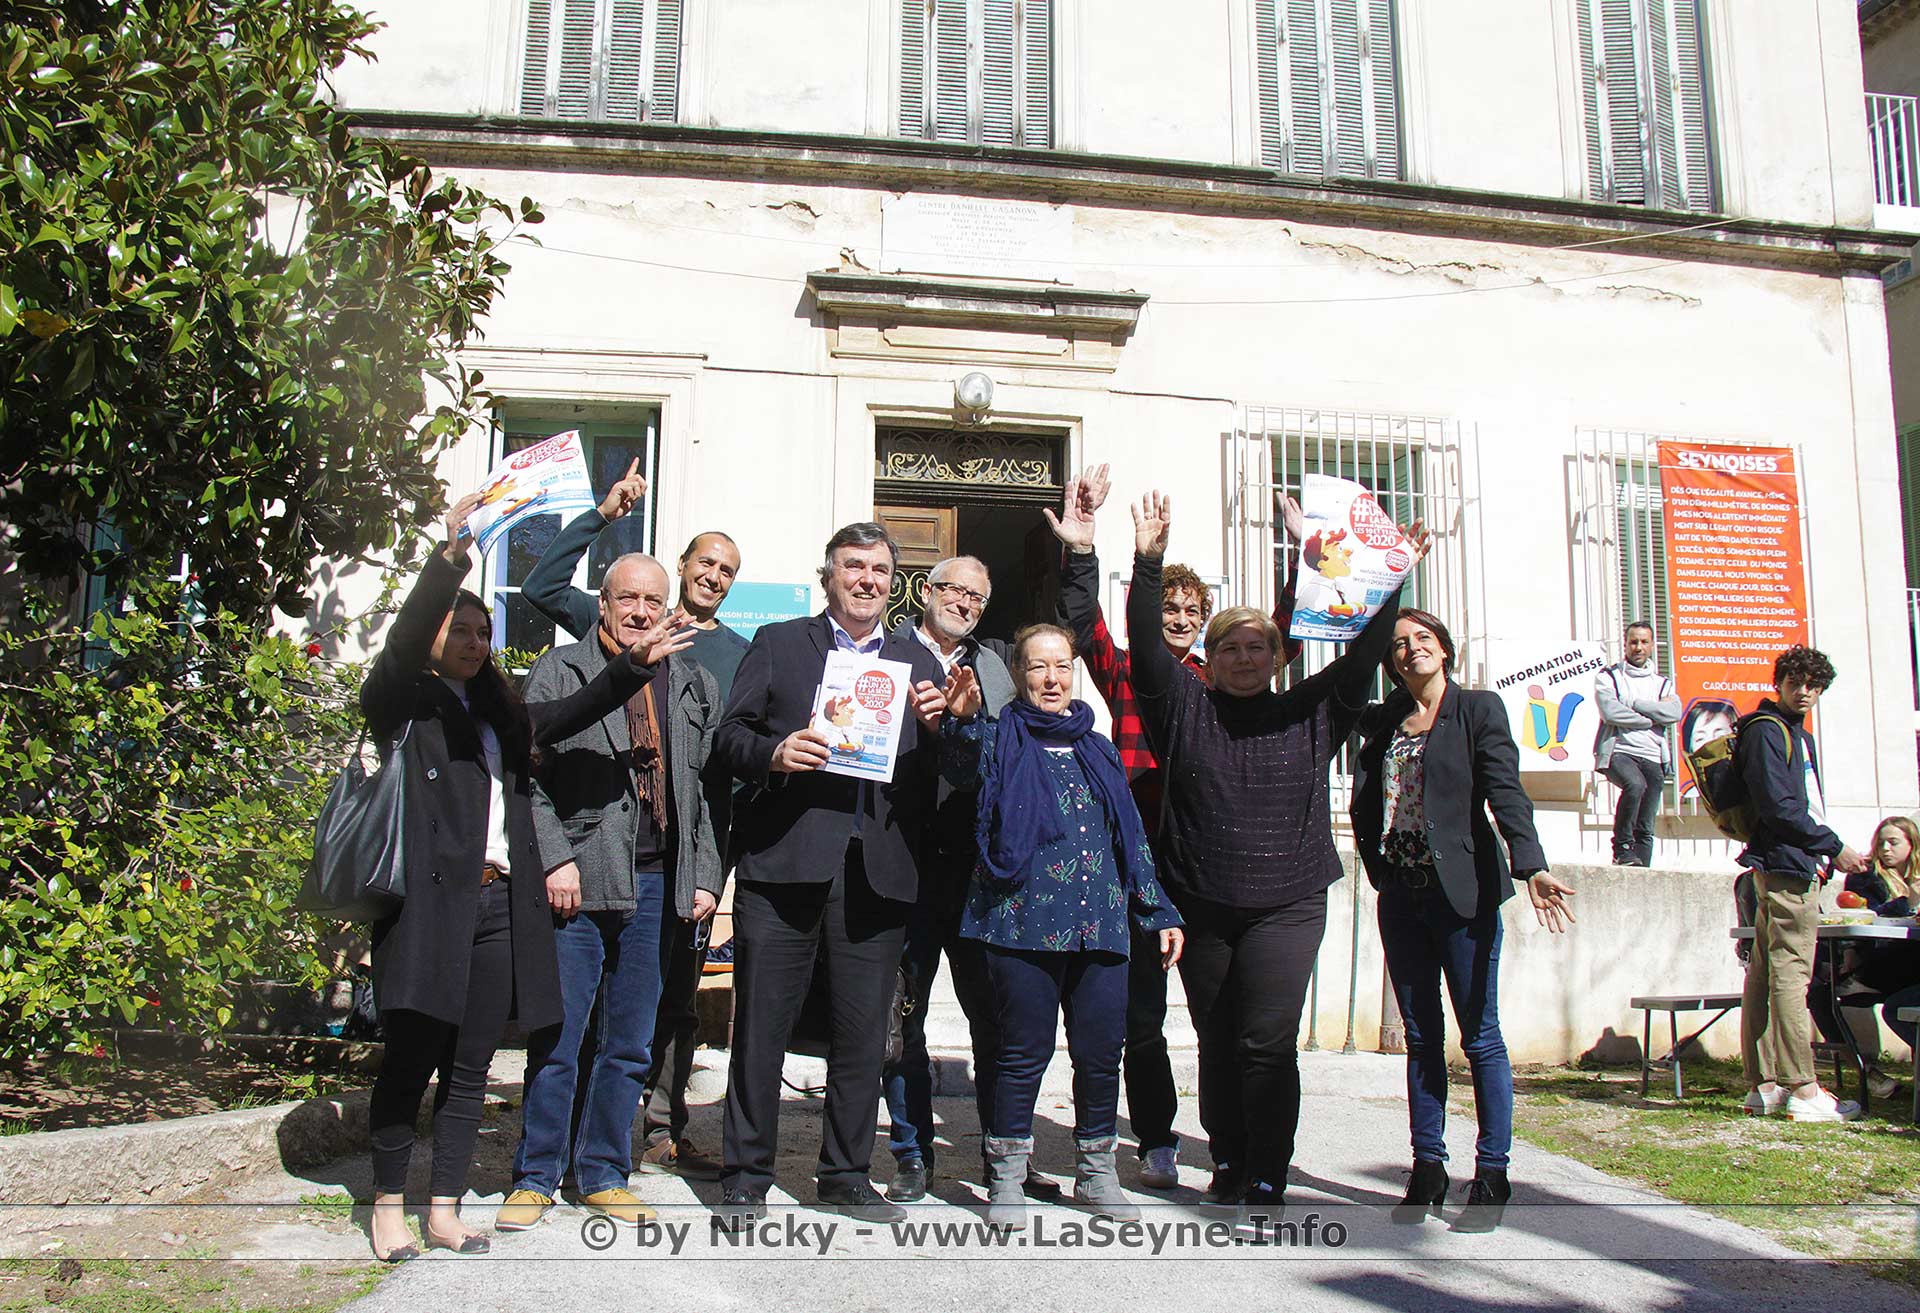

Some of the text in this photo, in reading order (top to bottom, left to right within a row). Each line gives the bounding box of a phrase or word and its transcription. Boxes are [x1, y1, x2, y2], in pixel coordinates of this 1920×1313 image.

[992, 206, 1037, 215] CASANOVA
[1677, 452, 1777, 473] SEYNOISES
[1685, 487, 1700, 496] QUE
[1761, 503, 1791, 512] BONNES
[1713, 512, 1749, 521] ALERTENT
[1674, 522, 1694, 530] MENT
[1709, 523, 1718, 531] LE
[1718, 524, 1733, 532] FAIT
[1366, 534, 1396, 547] 2020
[1674, 533, 1690, 541] RAIT
[1702, 534, 1729, 543] TOMBER
[1730, 536, 1750, 544] DANS
[1704, 547, 1725, 555] NOUS
[1726, 547, 1756, 556] SOMMES
[1757, 549, 1766, 557] EN
[1767, 549, 1787, 558] PLEIN
[1726, 559, 1747, 567] CELUI
[1750, 560, 1761, 568] DU
[1761, 561, 1788, 569] MONDE
[1676, 569, 1696, 577] DANS
[1696, 570, 1723, 578] LEQUEL
[1724, 571, 1745, 579] NOUS
[1774, 573, 1784, 581] EN
[1708, 582, 1739, 591] CHAQUE
[1760, 584, 1774, 592] DES
[1677, 592, 1785, 604] TAINES DE MILLIERS DE FEMMES
[1679, 604, 1699, 613] SONT
[1699, 605, 1732, 614] VICTIMES
[1733, 606, 1743, 614] DE
[755, 612, 765, 620] LA
[1679, 616, 1694, 625] DES
[1694, 617, 1727, 626] DIZAINES
[1727, 618, 1737, 626] DE
[1737, 619, 1768, 627] MILLIERS
[1680, 628, 1702, 636] SIONS
[1743, 630, 1753, 638] ET
[1753, 631, 1766, 639] DES
[1680, 640, 1705, 649] TAINES
[1706, 641, 1717, 649] DE
[1740, 642, 1771, 651] CHAQUE
[1728, 656, 1745, 665] ELLE
[1745, 657, 1759, 665] EST
[1496, 649, 1583, 690] INFORMATION
[1548, 657, 1603, 686] JEUNESSE
[1702, 681, 1746, 691] CAROLINE
[1746, 682, 1760, 691] DE
[864, 700, 885, 709] 2020
